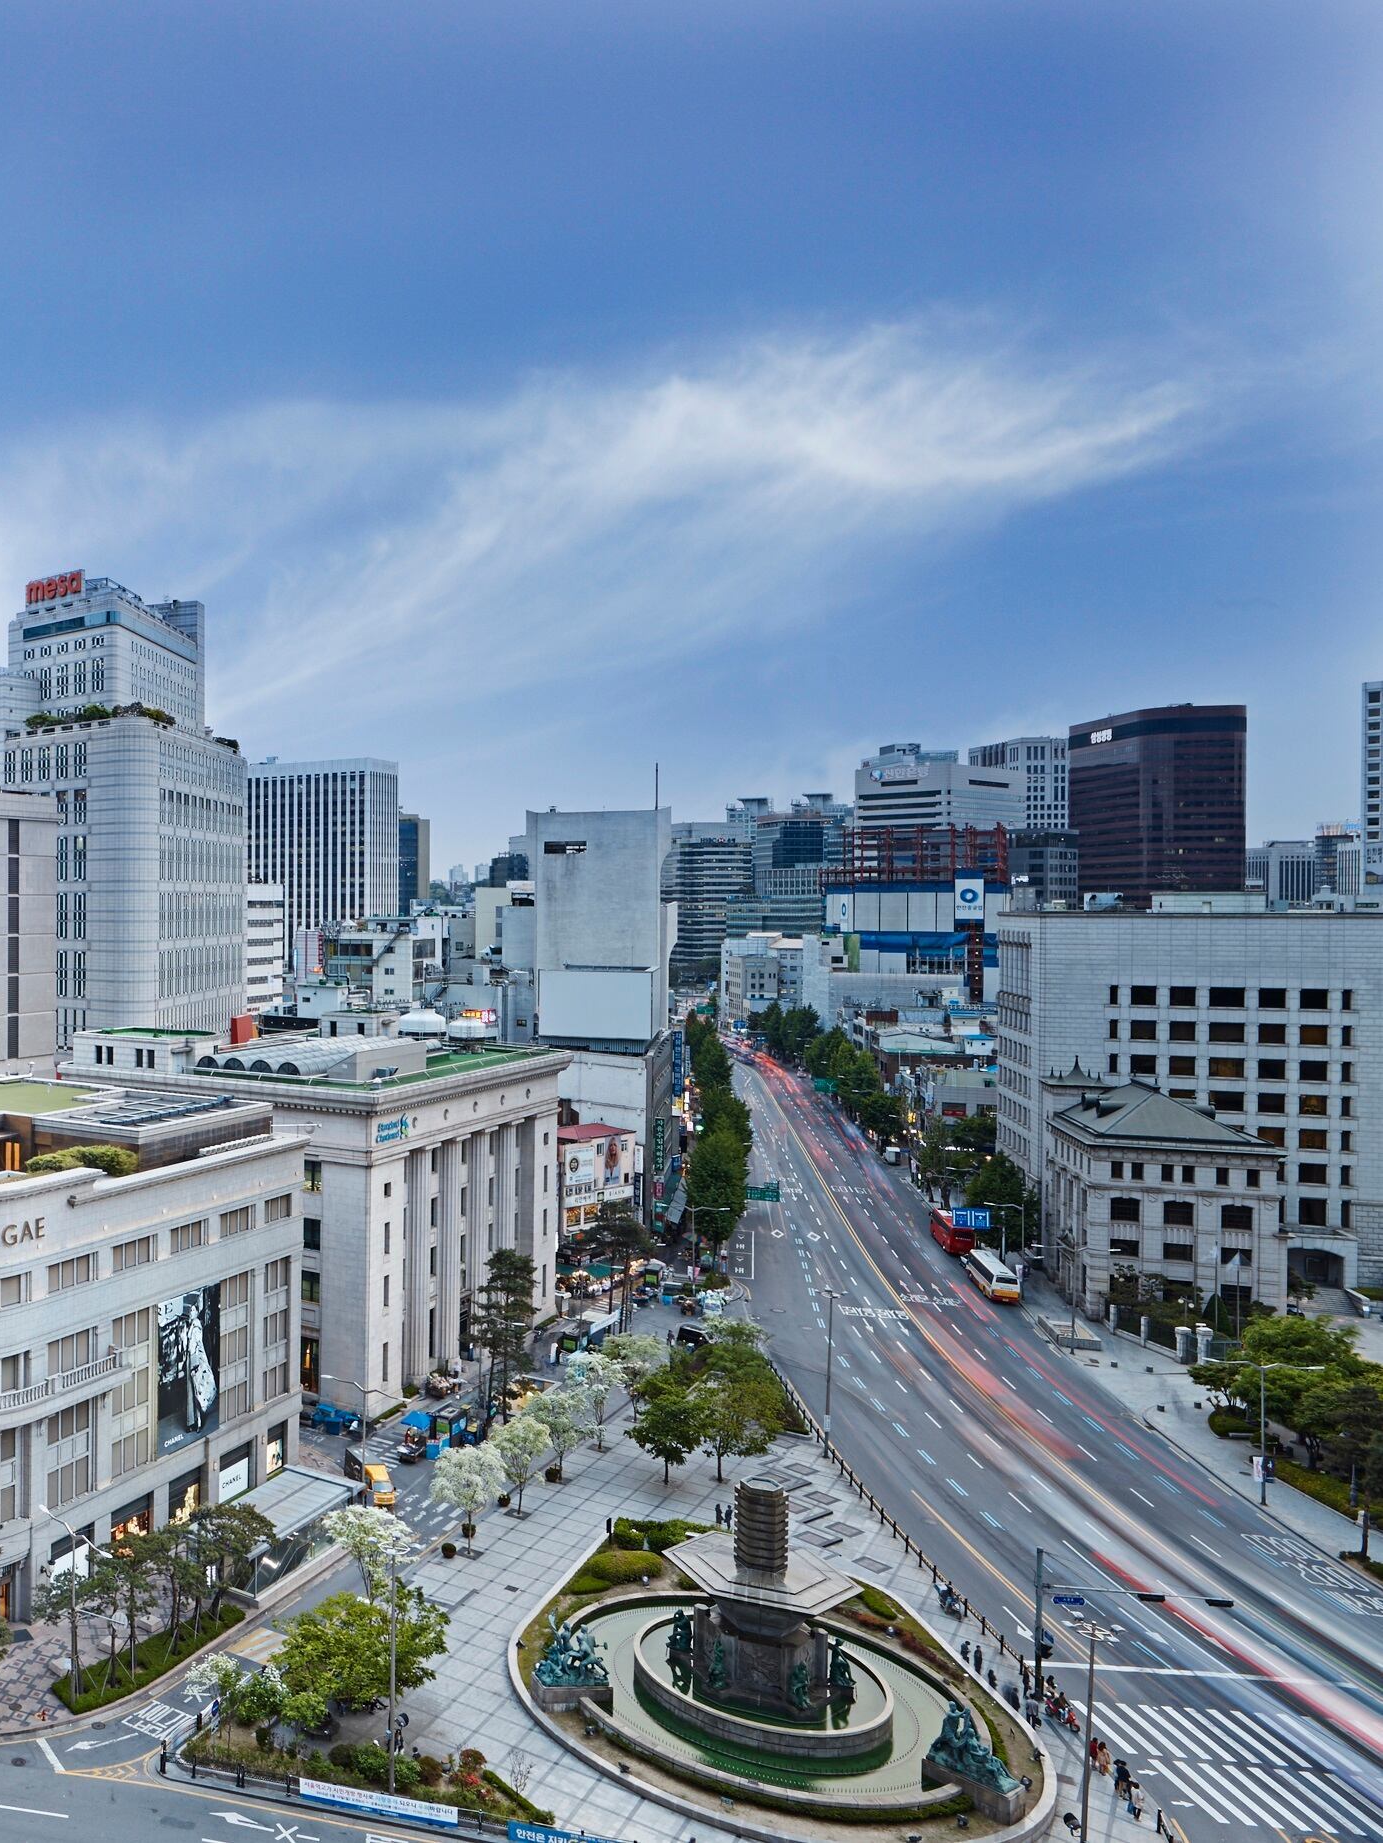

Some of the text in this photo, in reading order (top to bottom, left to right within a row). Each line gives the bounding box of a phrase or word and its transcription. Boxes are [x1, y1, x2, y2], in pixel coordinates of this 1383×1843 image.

[26, 571, 82, 604] mesa
[884, 764, 930, 780] 신한은행
[163, 1433, 185, 1448] CHANEL
[221, 1474, 243, 1489] CHANEL
[516, 1828, 546, 1843] 안전은
